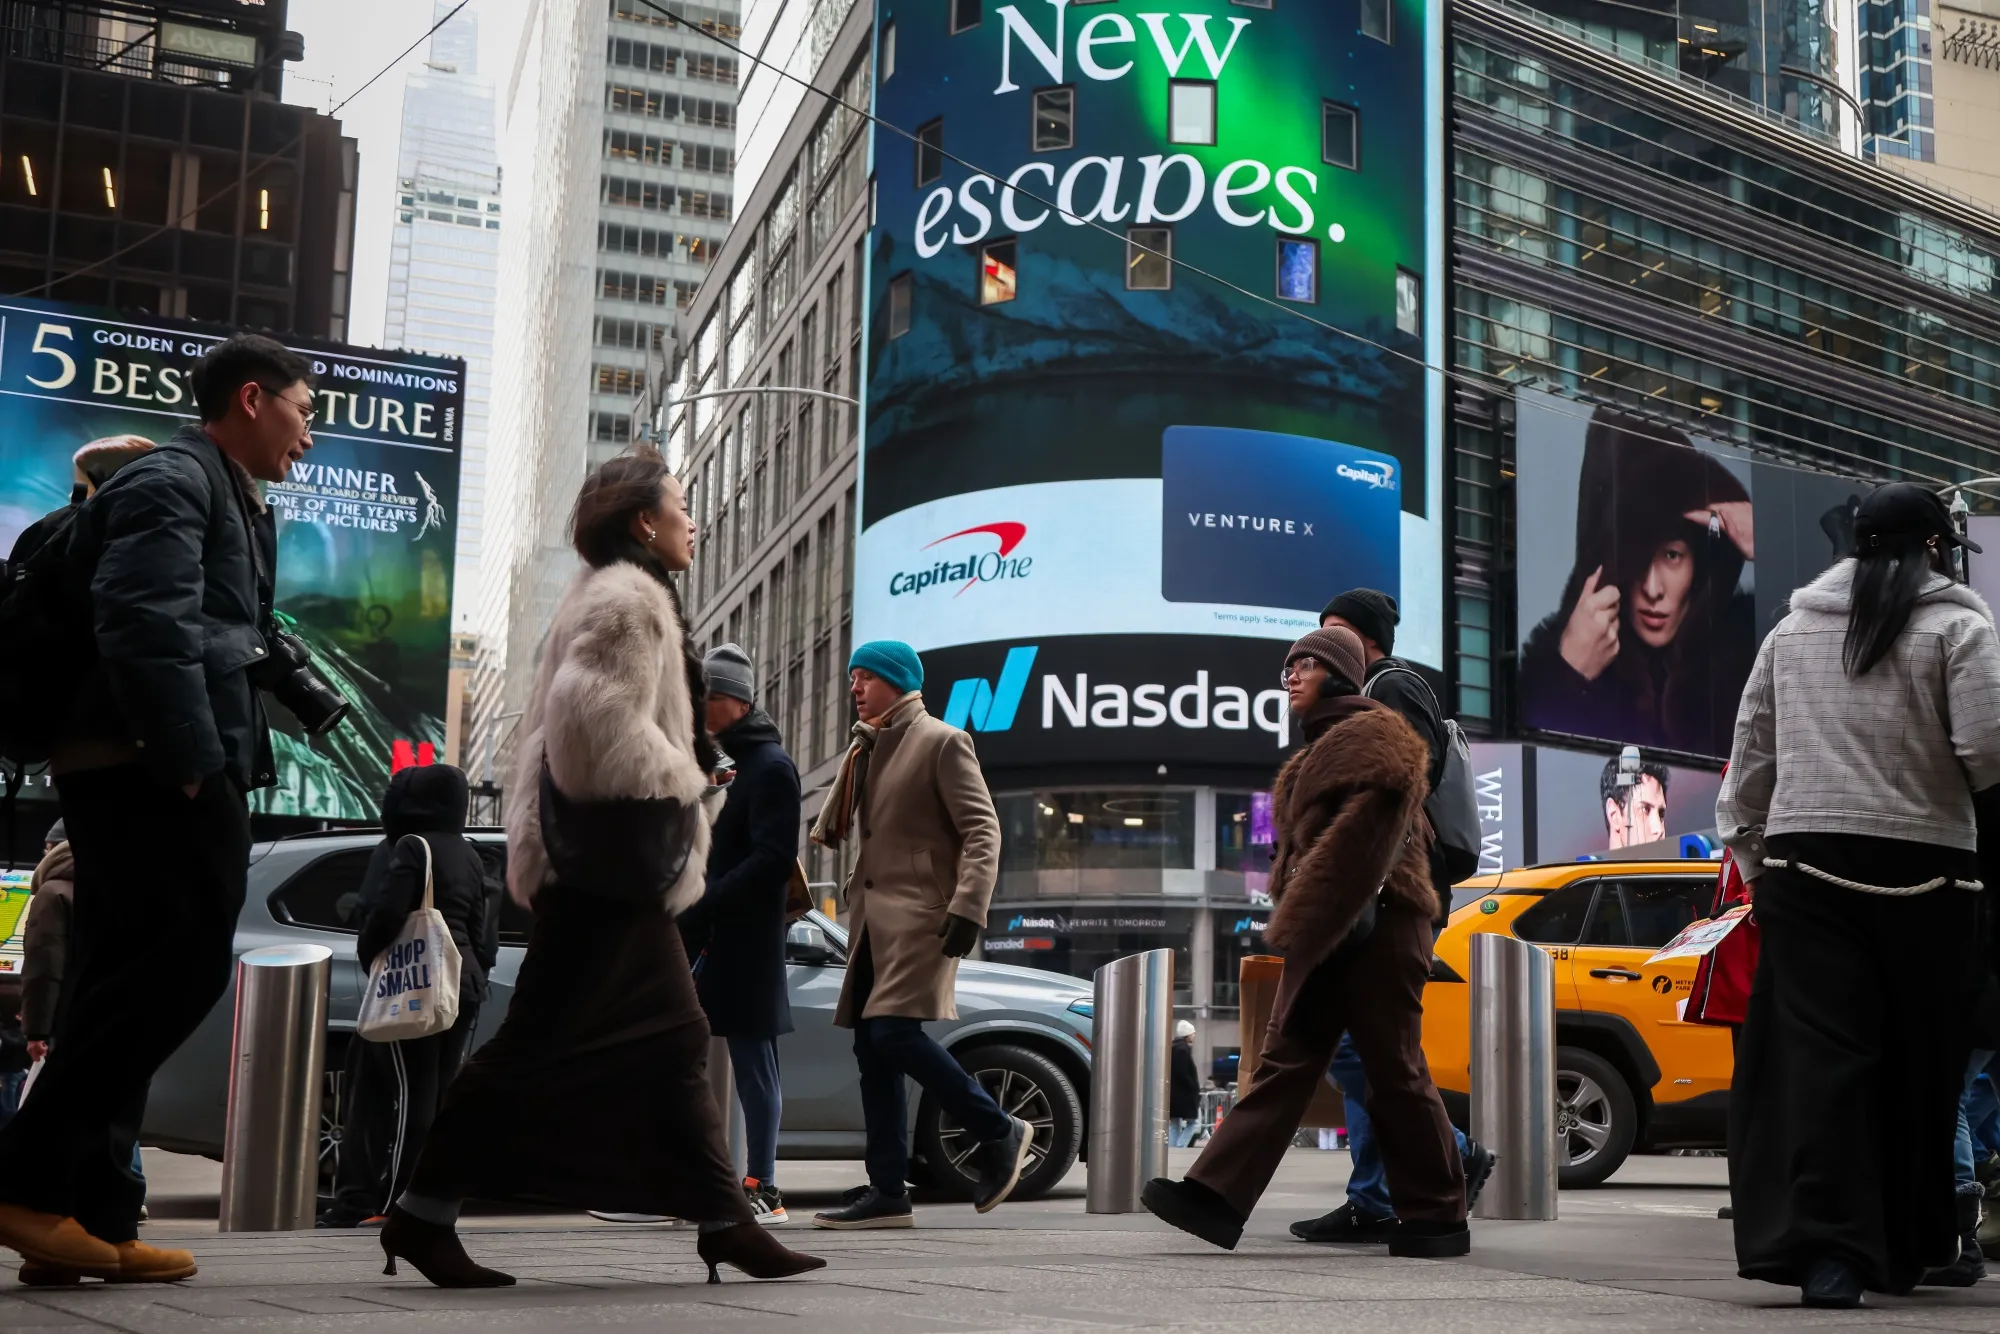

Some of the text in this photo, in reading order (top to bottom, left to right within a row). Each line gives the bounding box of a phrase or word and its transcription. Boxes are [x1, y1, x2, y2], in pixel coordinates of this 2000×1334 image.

[993, 0, 1252, 95] New
[914, 153, 1346, 259] escapes.
[25, 322, 77, 390] 5
[93, 329, 173, 353] GOLDEN
[92, 357, 200, 407] BES
[332, 364, 459, 394] NOMINATIONS
[308, 388, 437, 439] TURE
[443, 406, 456, 443] DRAMA
[266, 481, 419, 506] NATIONAL BOARD OF REVIEW
[291, 461, 398, 494] WINNER
[264, 493, 418, 523] ONE OF THE YEAR'S
[283, 508, 399, 533] BEST PICTURES
[1188, 512, 1314, 536] VENTURE X
[1213, 611, 1238, 621] Terms
[1264, 615, 1278, 624] See
[1041, 669, 1290, 749] Nasdaq
[1022, 918, 1055, 929] Nasdaq
[1113, 919, 1167, 928] TOMORROW
[383, 939, 426, 972] SHOP
[984, 938, 1025, 951] branded
[376, 964, 432, 999] SMALL
